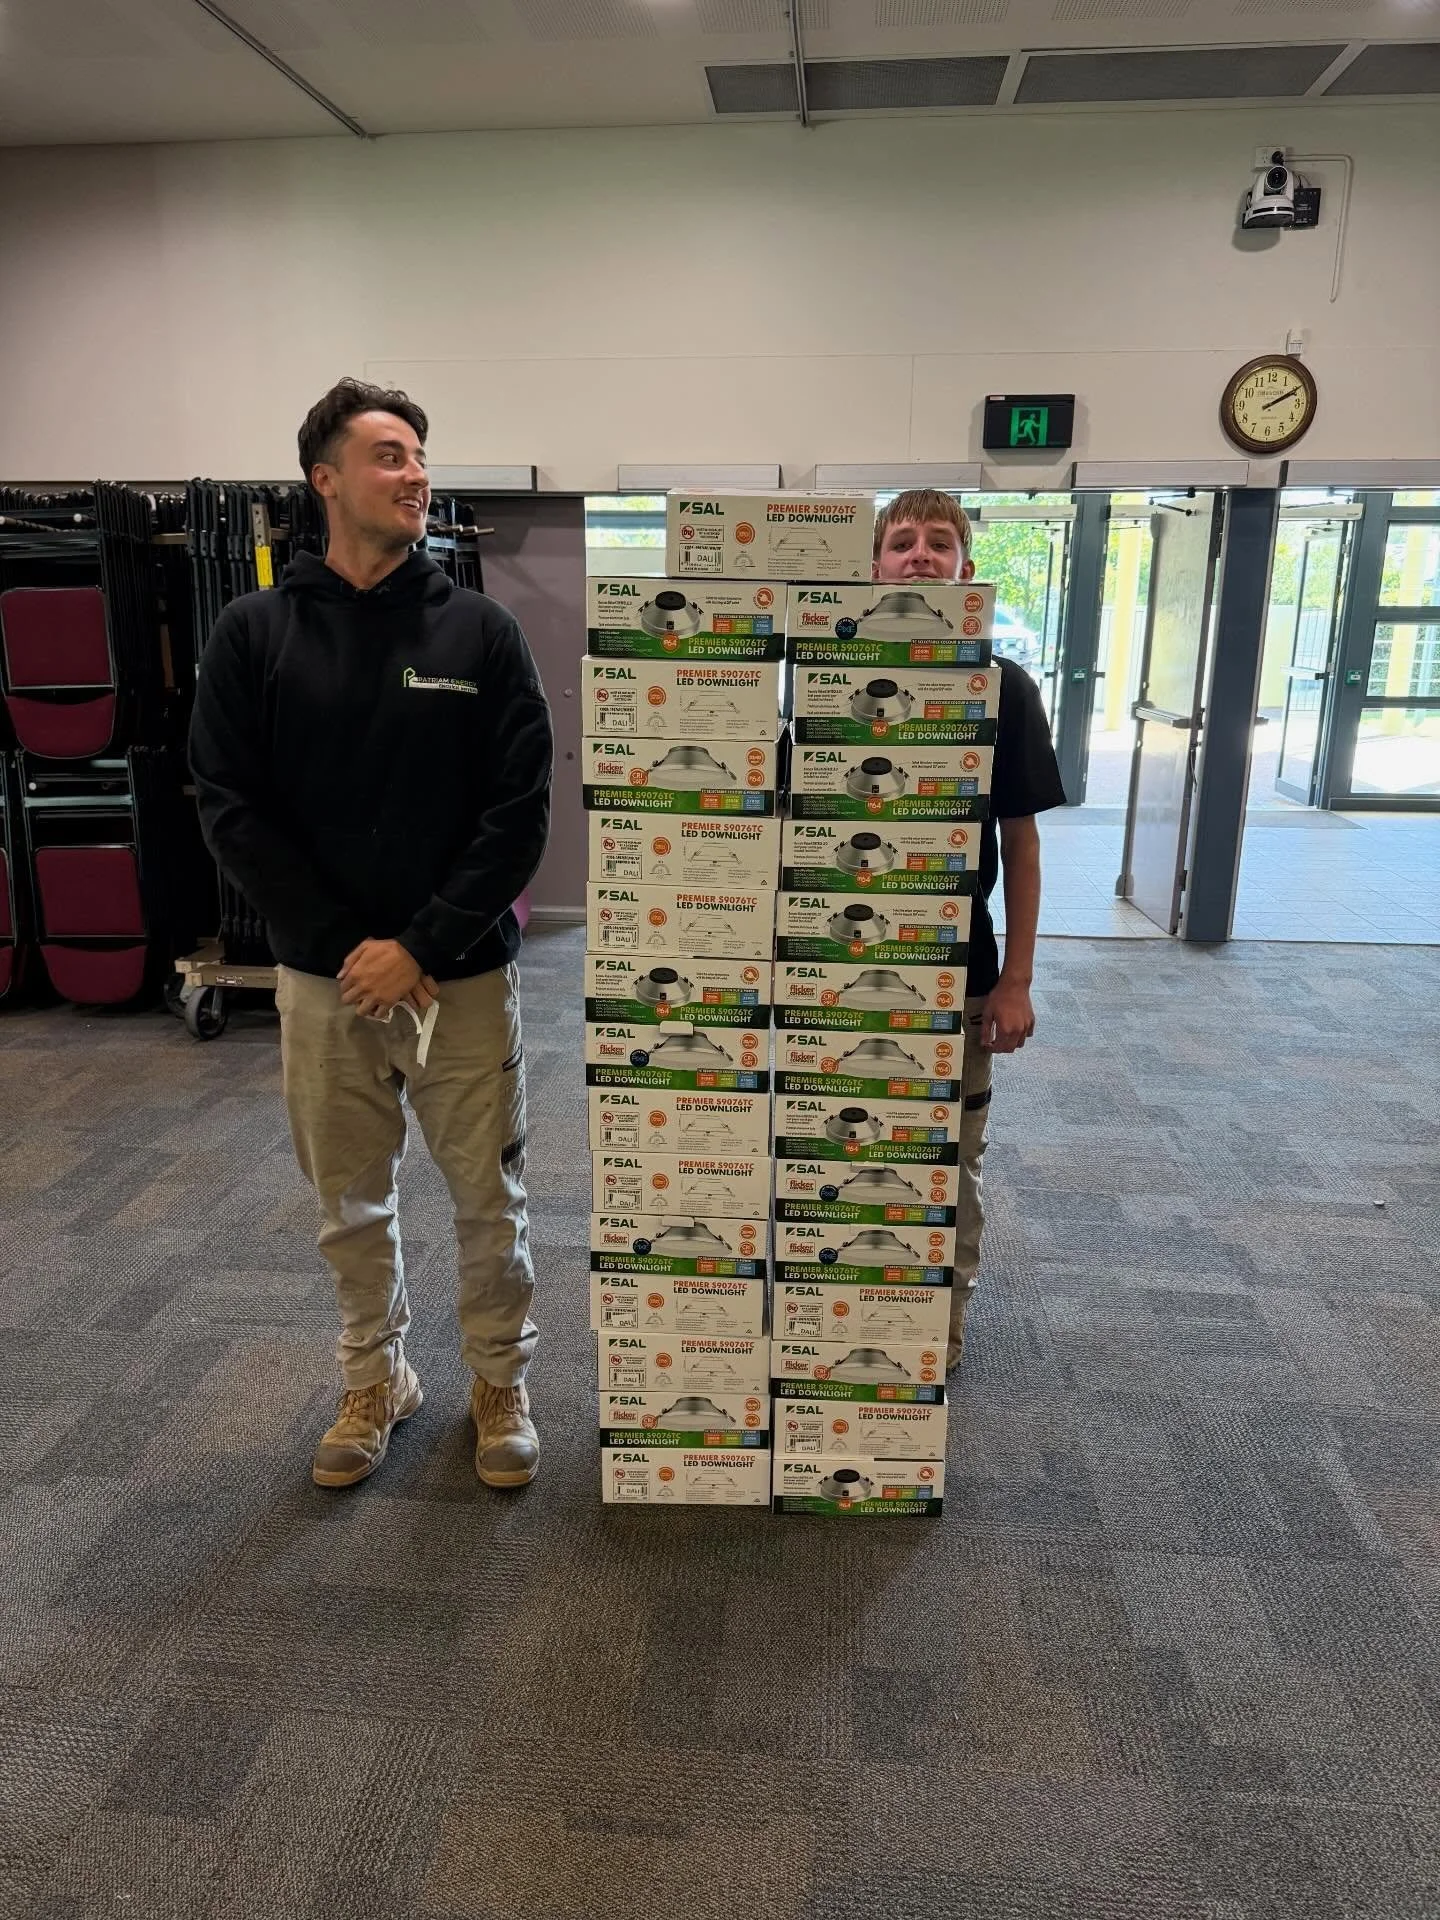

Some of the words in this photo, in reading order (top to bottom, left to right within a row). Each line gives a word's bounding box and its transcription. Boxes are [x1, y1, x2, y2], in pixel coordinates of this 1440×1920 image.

[1268, 372, 1277, 382] 12
[1284, 376, 1288, 386] 1
[1255, 377, 1264, 387] 11
[1245, 388, 1254, 398] 10
[1239, 401, 1245, 410] 9
[1295, 399, 1300, 409] 3
[1242, 414, 1248, 423] 8
[1289, 411, 1294, 422] 4
[1252, 423, 1256, 433] 7
[1265, 426, 1270, 436] 6
[1279, 422, 1284, 432] 5
[692, 502, 724, 515] SAL
[767, 504, 811, 513] PREMIER
[814, 506, 856, 514] S9076TC
[767, 514, 785, 522] LED
[789, 515, 854, 523] DOWNLIGHT
[609, 584, 640, 596] SAL
[810, 592, 842, 604] SAL
[802, 613, 829, 622] flicker
[689, 646, 704, 654] LED
[708, 647, 765, 655] DOWNLIGHT
[797, 643, 838, 651] PREMIER
[817, 653, 879, 661] DOWNLIGHT
[606, 668, 636, 679] SAL
[819, 673, 851, 685] SAL
[940, 724, 978, 732] S9076TC
[917, 732, 976, 740] DOWNLIGHT
[605, 744, 635, 755] SAL
[816, 752, 847, 762] SAL
[598, 763, 623, 771] flicker
[594, 790, 632, 798] PREMIER
[636, 792, 674, 800] S9076TC
[615, 799, 672, 808] DOWNLIGHT
[912, 808, 969, 816] DOWNLIGHT
[613, 819, 642, 830] SAL
[682, 822, 721, 830] PREMIER
[723, 824, 763, 832] S9076TC
[701, 831, 761, 840] DOWNLIGHT
[806, 827, 836, 837] SAL
[900, 882, 958, 890] DOWNLIGHT
[610, 891, 639, 901] SAL
[677, 894, 716, 902] PREMIER
[718, 896, 757, 904] S9076TC
[696, 903, 755, 912] DOWNLIGHT
[800, 898, 830, 909] SAL
[893, 953, 949, 961] DOWNLIGHT
[607, 961, 636, 971] SAL
[798, 968, 827, 978] SAL
[790, 985, 815, 993] flicker
[698, 1015, 751, 1023] DOWNLIGHT
[785, 1010, 824, 1018] PREMIER
[826, 1011, 864, 1019] S9076TC
[804, 1018, 862, 1026] DOWNLIGHT
[607, 1028, 635, 1038] SAL
[797, 1035, 827, 1046] SAL
[614, 1077, 670, 1085] DOWNLIGHT
[804, 1084, 861, 1093] DOWNLIGHT
[611, 1095, 639, 1105] SAL
[716, 1098, 753, 1106] S9076TC
[695, 1105, 752, 1113] DOWNLIGHT
[797, 1101, 826, 1111] SAL
[614, 1158, 642, 1168] SAL
[679, 1160, 715, 1168] PREMIER
[797, 1164, 826, 1174] SAL
[610, 1219, 638, 1228] SAL
[797, 1228, 824, 1237] SAL
[618, 1263, 672, 1272] DOWNLIGHT
[803, 1273, 858, 1281] DOWNLIGHT
[611, 1278, 638, 1288] SAL
[692, 1288, 746, 1296] DOWNLIGHT
[796, 1287, 823, 1296] SAL
[620, 1339, 646, 1348] SAL
[792, 1346, 819, 1355] SAL
[799, 1390, 852, 1398] DOWNLIGHT
[620, 1397, 646, 1405] SAL
[796, 1406, 823, 1414] SAL
[622, 1454, 649, 1462] SAL
[794, 1464, 821, 1473] SAL
